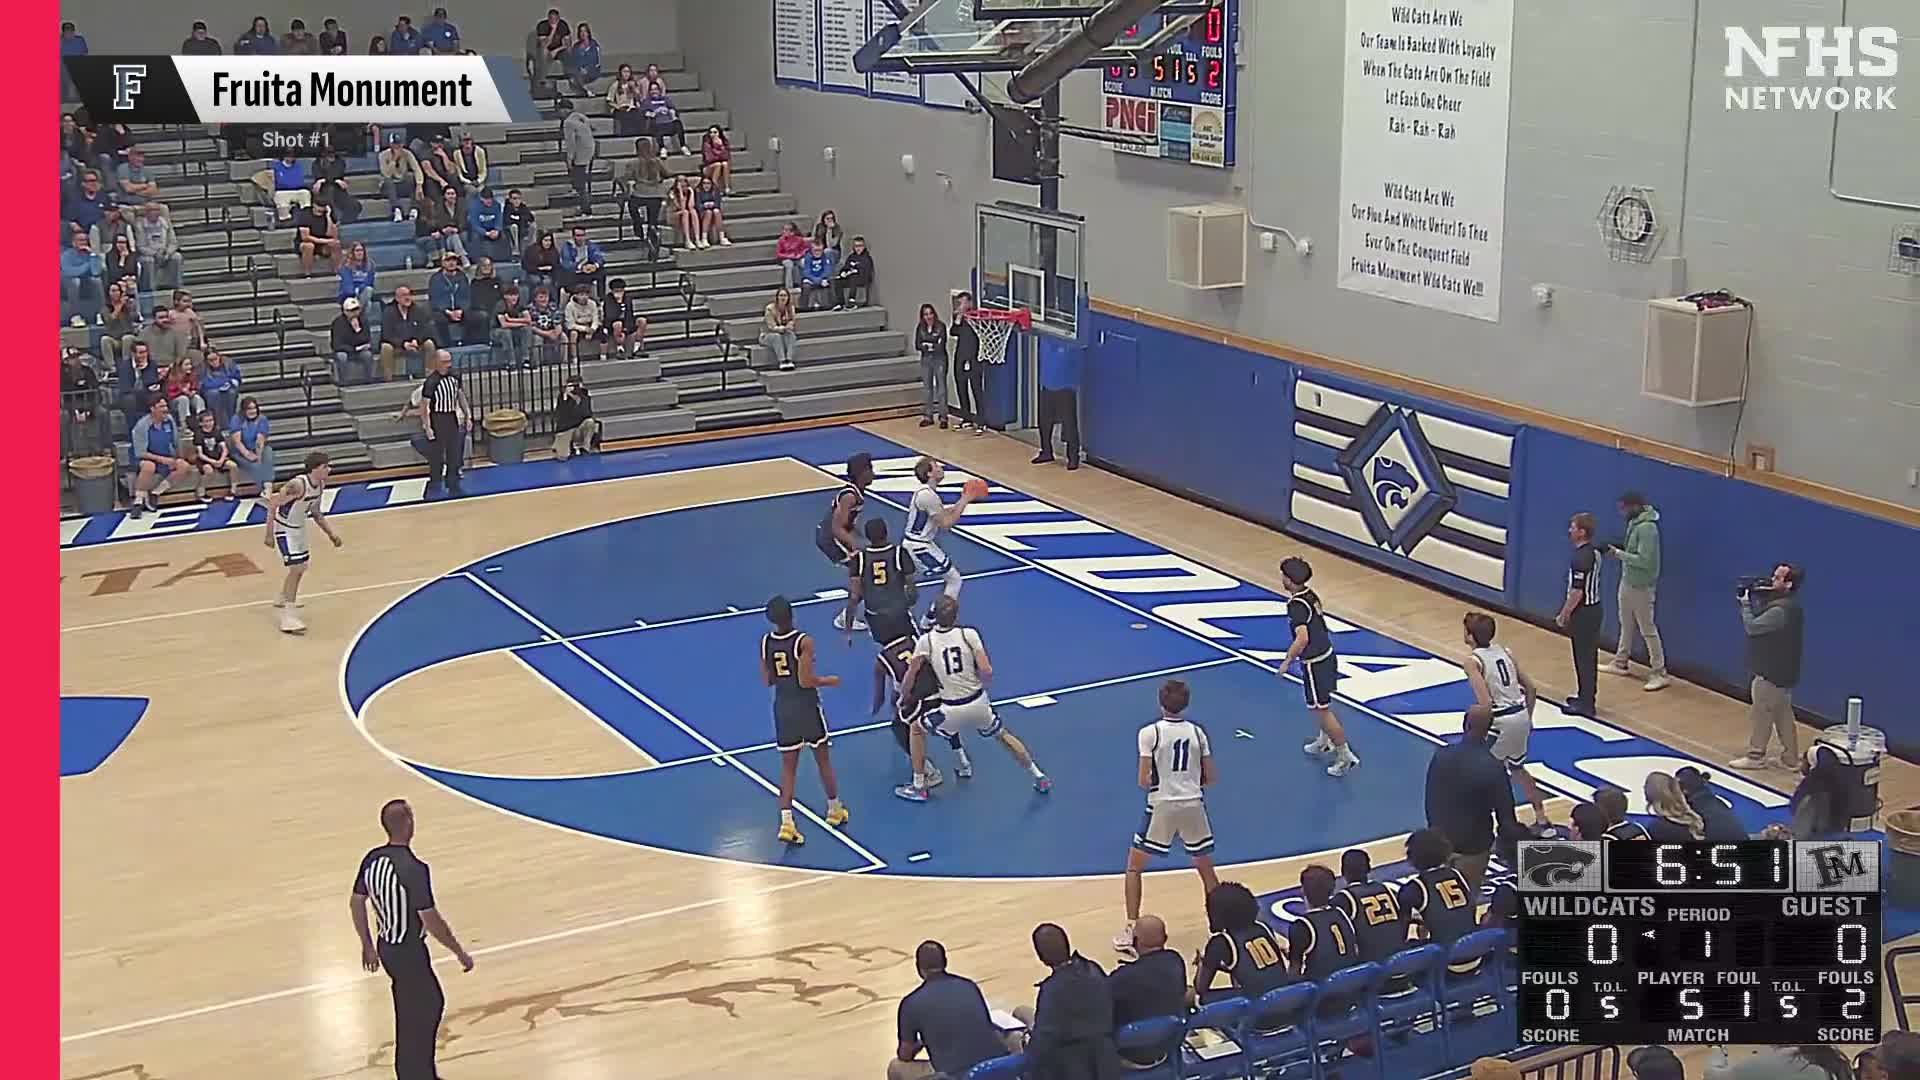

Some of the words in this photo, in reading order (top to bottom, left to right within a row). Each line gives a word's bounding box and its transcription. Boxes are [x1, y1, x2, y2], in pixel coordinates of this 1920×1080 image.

[1392, 7, 1410, 24] Wild
[1412, 8, 1431, 25] Cats
[1432, 9, 1447, 26] Are
[1449, 10, 1463, 27] We
[1360, 32, 1374, 48] Our
[1376, 33, 1397, 50] Team
[1399, 35, 1405, 51] Is
[1407, 35, 1436, 53] Backed
[1438, 37, 1460, 56] With
[1462, 39, 1496, 61] Loyalty
[1207, 60, 1220, 87] 2
[1363, 59, 1386, 77] When
[1388, 62, 1402, 79] The
[1404, 63, 1422, 80] Cats
[1424, 65, 1438, 82] Are
[1440, 66, 1452, 84] On
[1454, 68, 1469, 85] The
[1471, 69, 1491, 87] Field
[1385, 88, 1398, 105] Let
[1400, 90, 1420, 107] Each
[1421, 92, 1436, 109] One
[1437, 94, 1462, 112] Cheer
[1389, 117, 1405, 133] Rah
[1413, 120, 1430, 136] Rah
[1438, 123, 1456, 140] Rah
[1384, 182, 1402, 199] Wild
[1404, 185, 1422, 203] Cats
[1424, 187, 1439, 206] Are
[1441, 191, 1455, 208] We
[1352, 203, 1365, 220] Our
[1367, 206, 1382, 223] Blue
[1384, 209, 1400, 226] And
[1402, 212, 1427, 231] White
[1428, 216, 1456, 236] Unfurl
[1458, 222, 1466, 238] To
[1469, 223, 1488, 242] Thee
[1365, 233, 1383, 250] Ever
[1385, 236, 1395, 252] On
[1397, 239, 1411, 256] The
[1413, 242, 1450, 264] Conquest
[1451, 248, 1470, 267] Field
[1351, 256, 1376, 275] Fruita
[1378, 261, 1421, 285] Monument
[1423, 270, 1441, 289] Wild
[1442, 274, 1461, 294] Cats
[872, 561, 887, 585] 5
[773, 651, 791, 677] 2
[942, 646, 963, 675] 13
[1495, 657, 1511, 687] 0
[1172, 738, 1190, 772] 11
[1435, 879, 1468, 910] 15
[1361, 893, 1400, 926] 23
[1244, 936, 1279, 970] 10
[1330, 923, 1346, 955] 1
